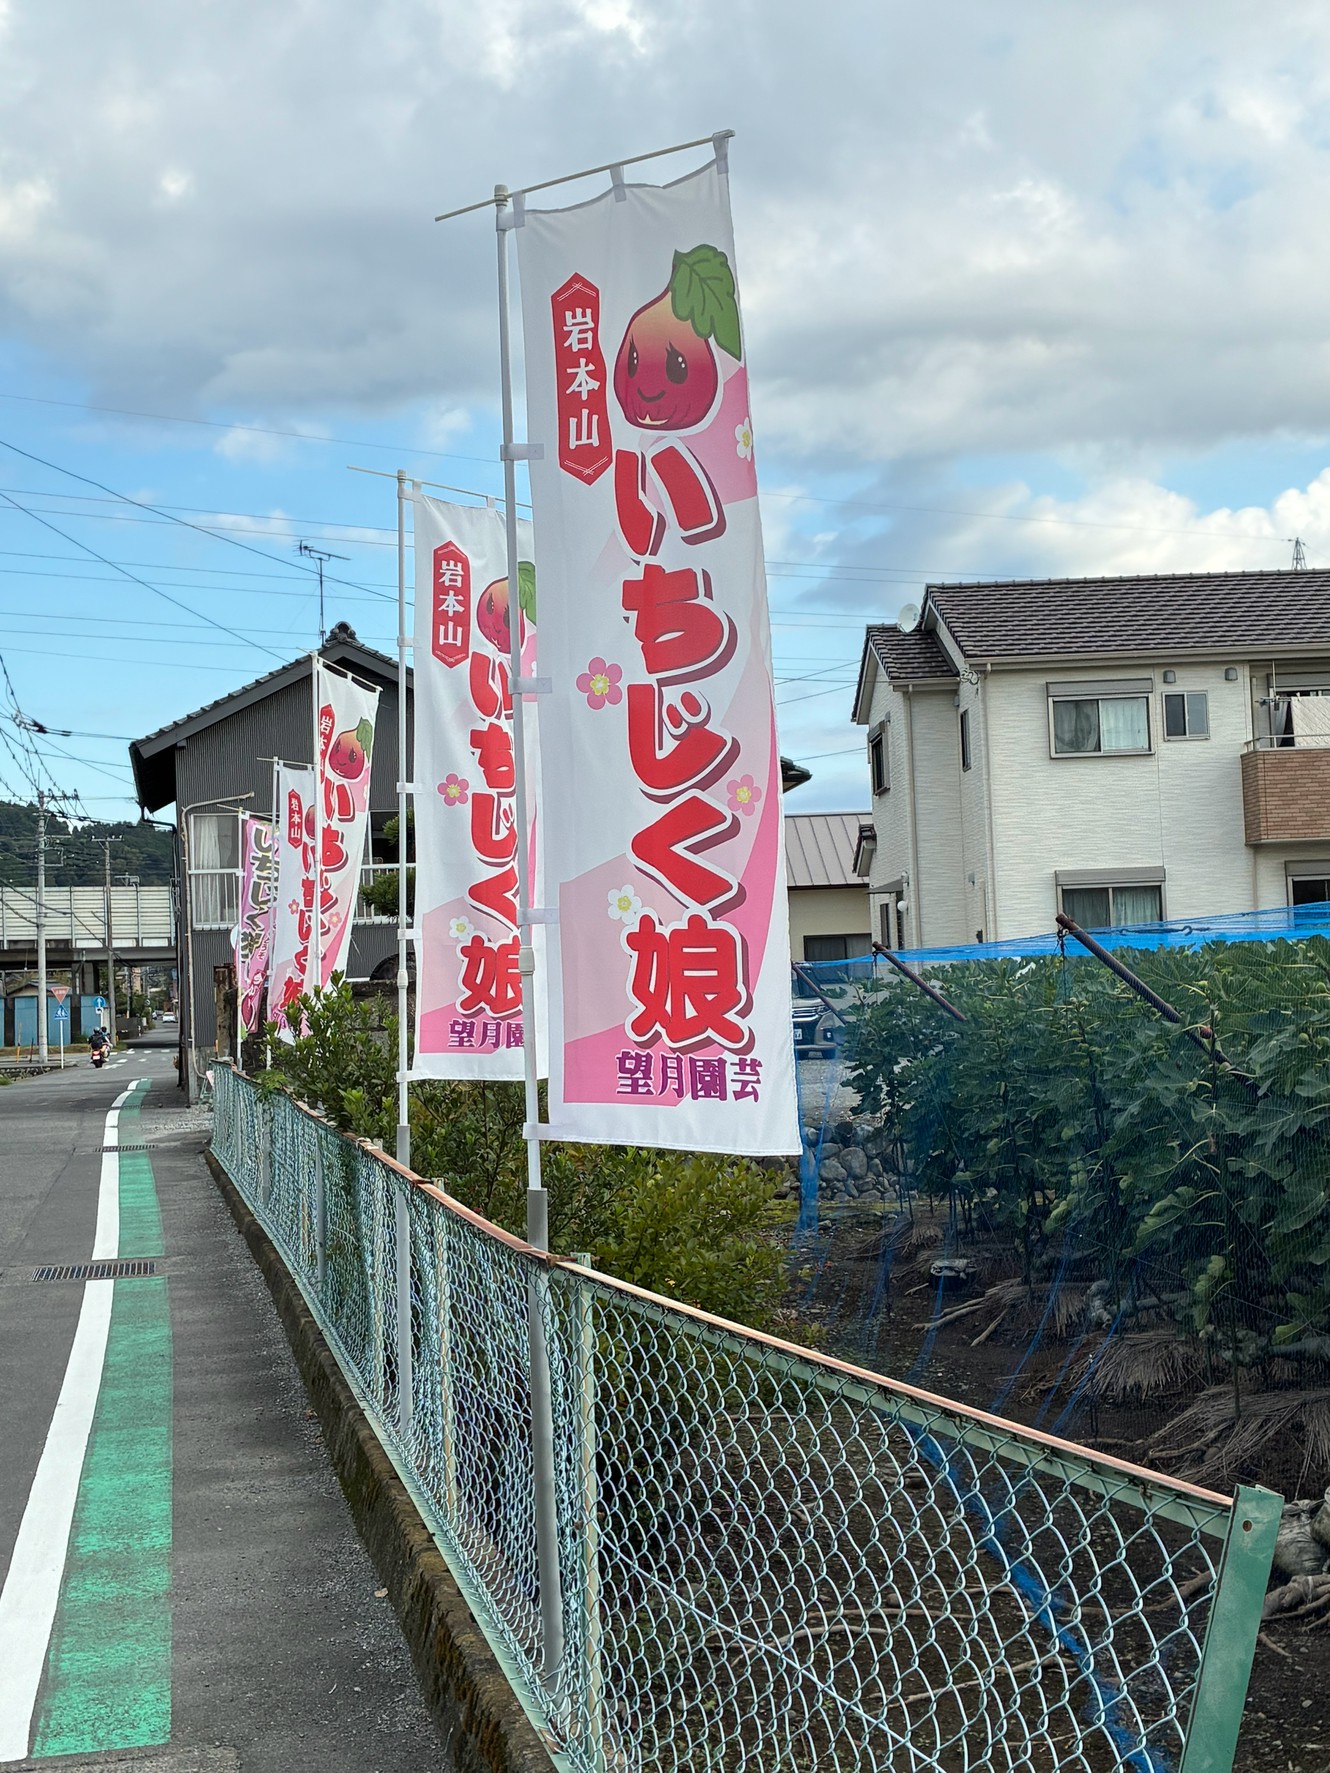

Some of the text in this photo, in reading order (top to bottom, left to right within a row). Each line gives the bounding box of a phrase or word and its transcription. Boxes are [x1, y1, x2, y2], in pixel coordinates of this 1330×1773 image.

[563, 308, 600, 450] 岩本山
[438, 560, 465, 647] 岩本山
[613, 440, 754, 1054] いちじく娘
[290, 797, 301, 839] 岩本山
[615, 1049, 762, 1103] 望月園芸
